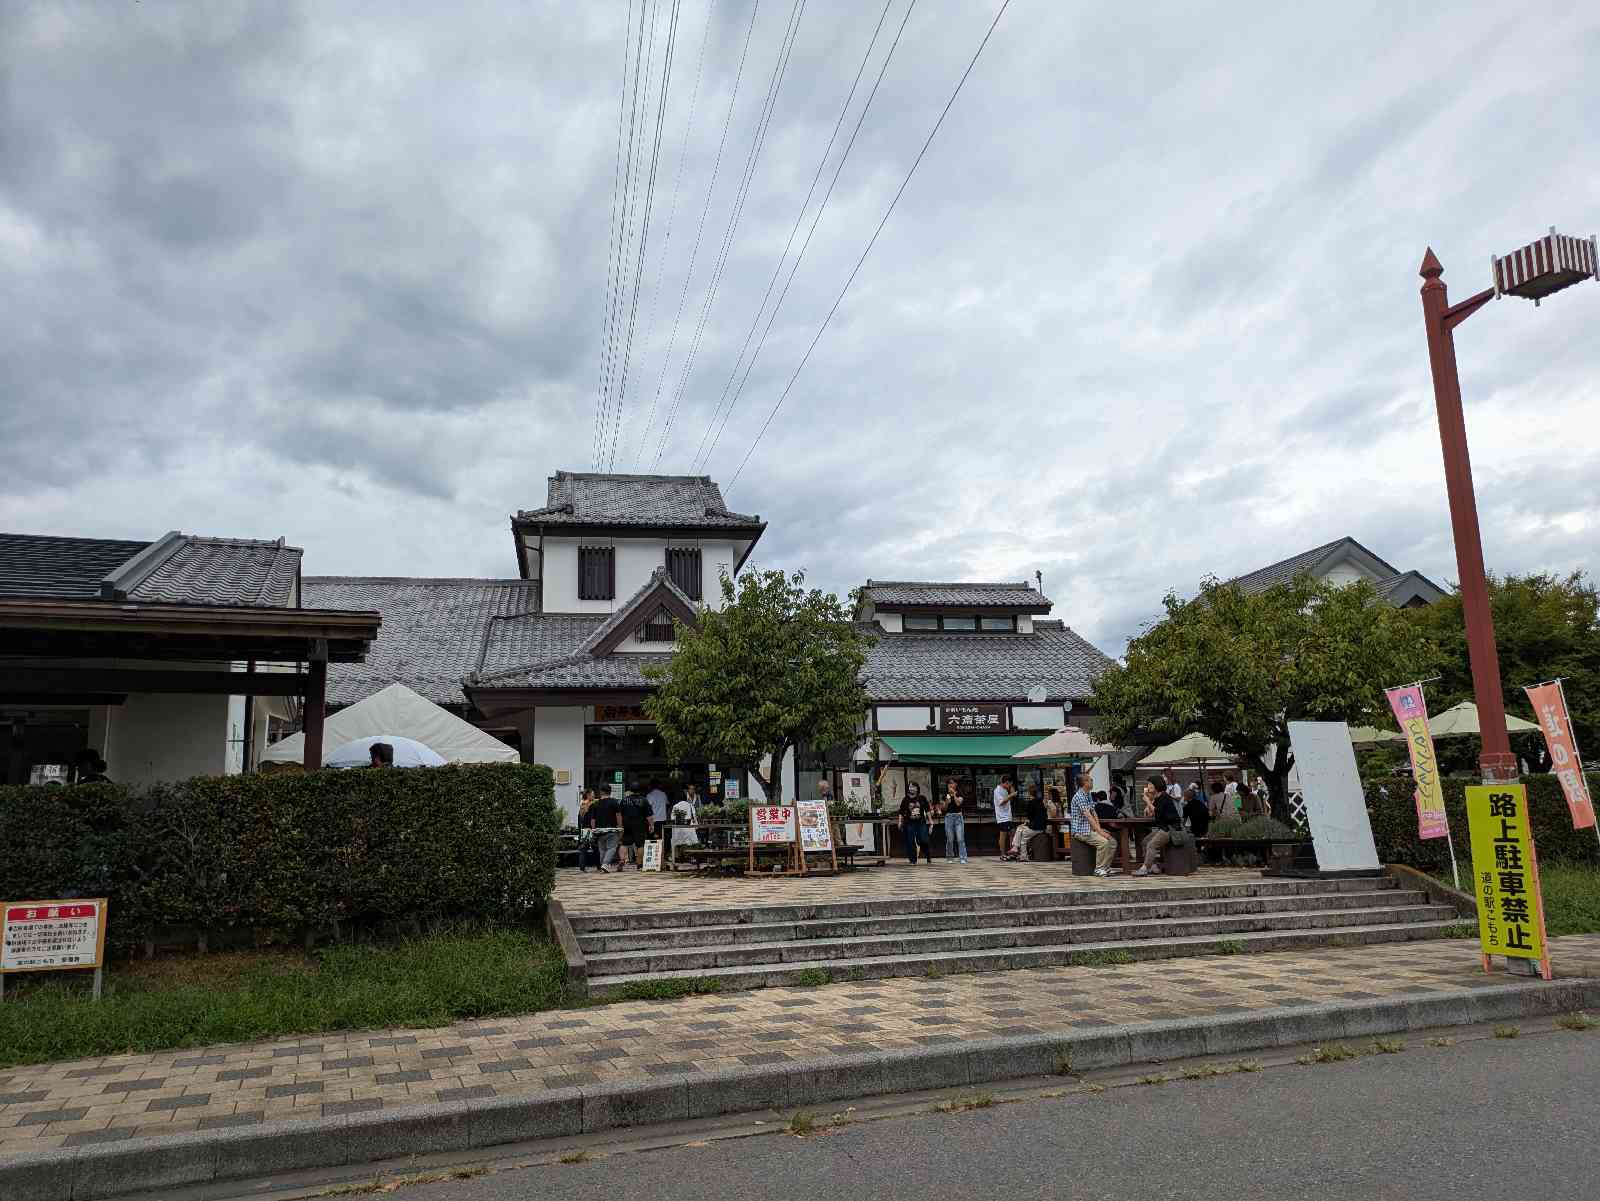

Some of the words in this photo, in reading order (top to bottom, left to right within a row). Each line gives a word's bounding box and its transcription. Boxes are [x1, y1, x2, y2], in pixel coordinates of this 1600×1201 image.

[756, 807, 790, 819] 営業中
[1488, 793, 1533, 950] 路上駐車禁止
